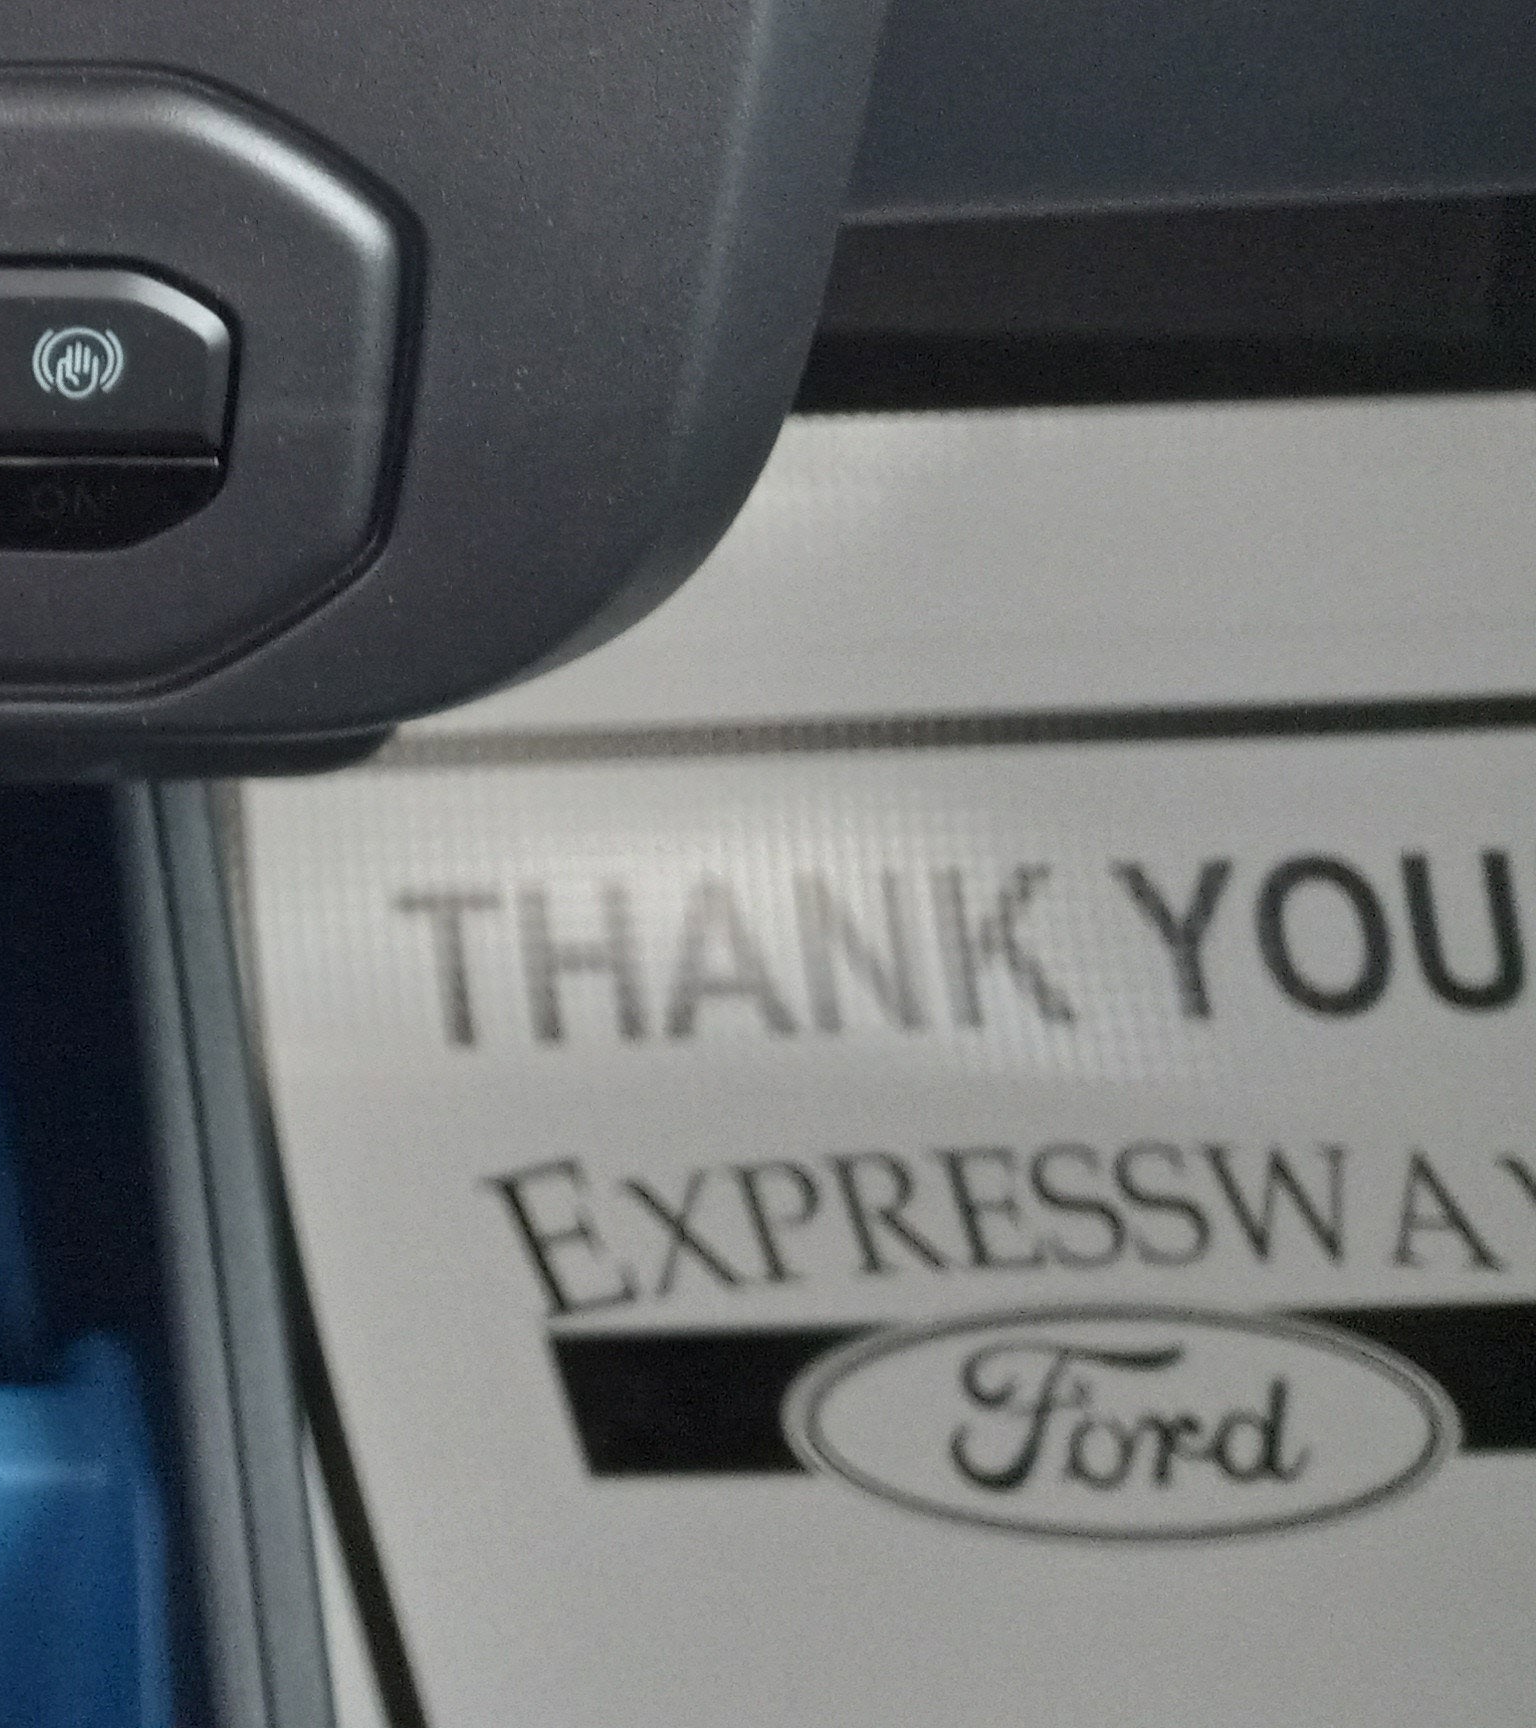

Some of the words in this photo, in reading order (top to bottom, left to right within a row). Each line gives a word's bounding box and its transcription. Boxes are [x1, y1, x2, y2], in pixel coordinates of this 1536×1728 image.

[397, 862, 1076, 1048] THANK
[1113, 848, 1525, 1023] YOU
[950, 1340, 1306, 1494] Ford
